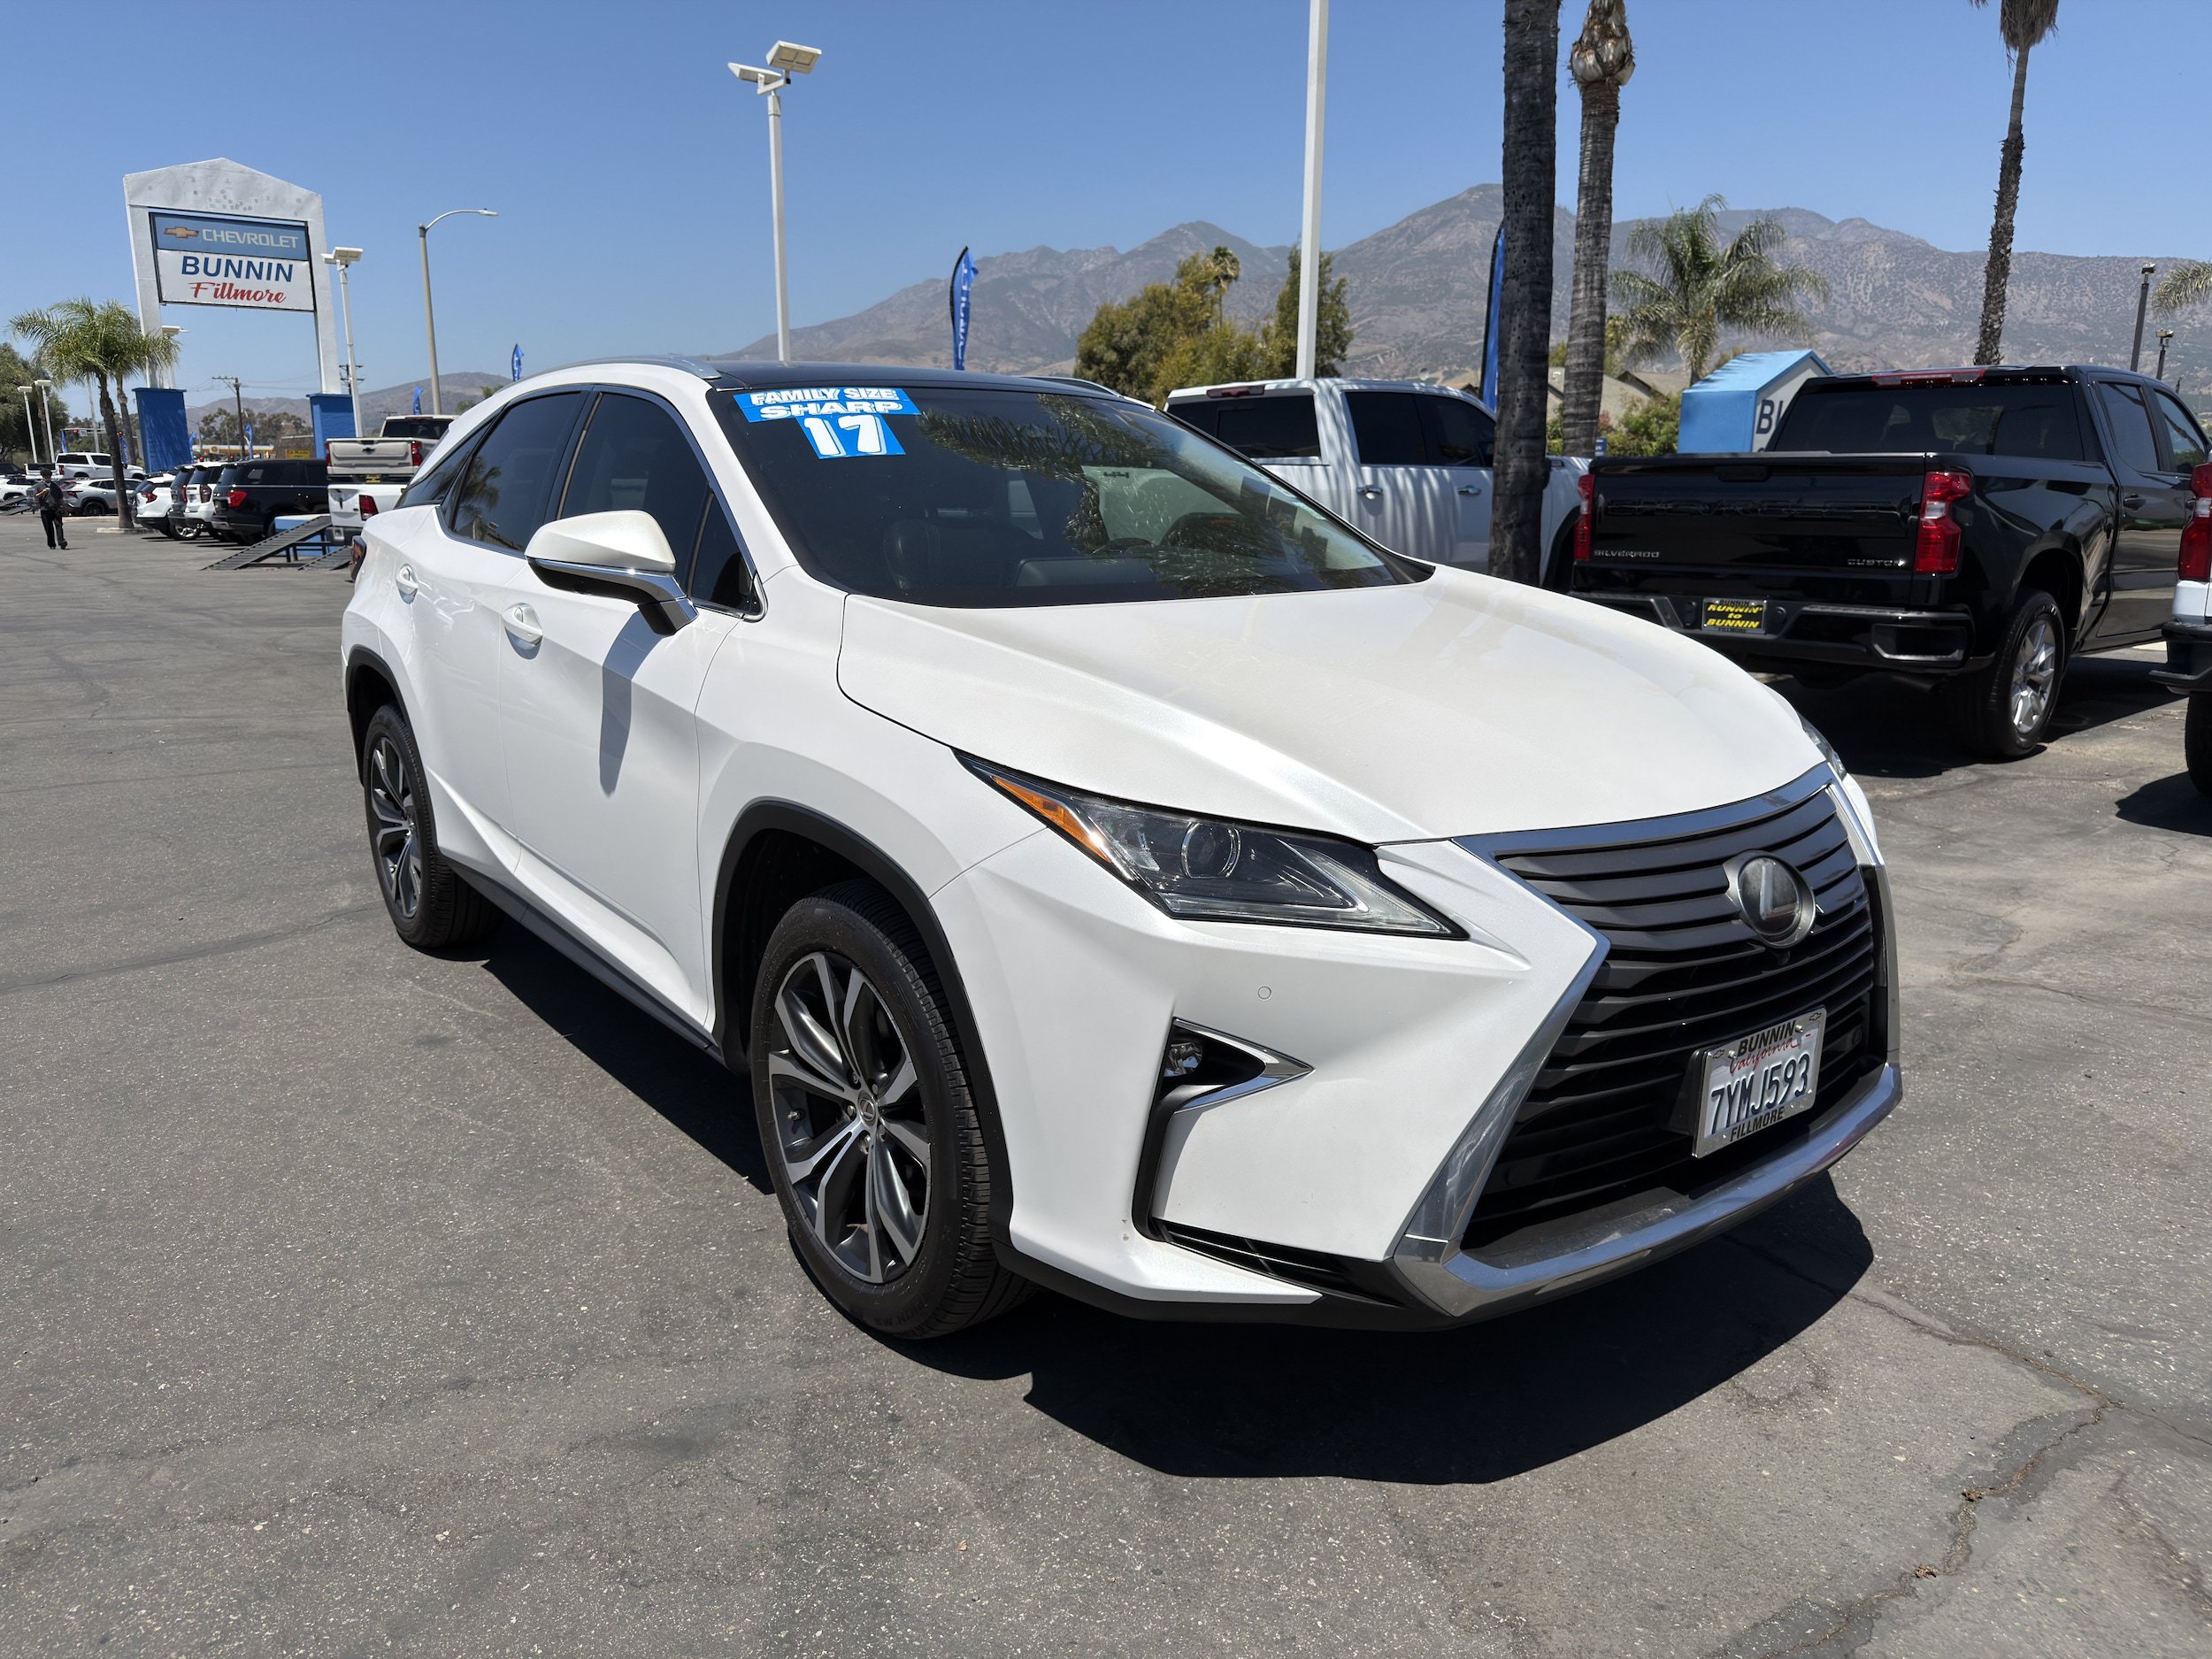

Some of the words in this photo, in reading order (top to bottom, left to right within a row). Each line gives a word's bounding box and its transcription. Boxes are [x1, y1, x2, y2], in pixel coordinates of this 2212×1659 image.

[203, 228, 298, 249] CHEVROLET
[181, 256, 294, 283] BUNNIN
[188, 281, 287, 303] Fillmore
[749, 388, 841, 407] FAMILY
[845, 388, 900, 401] SIZE
[760, 401, 903, 419] SHARP
[803, 414, 887, 457] 17
[1594, 549, 1660, 558] SILVERADO
[1847, 557, 1906, 567] CUSTOM
[1706, 618, 1760, 628] BUNNIN
[1737, 1020, 1797, 1057] BUNNIN
[1710, 1053, 1810, 1135] 7YMJ593
[1730, 1106, 1785, 1142] FILLMORE
